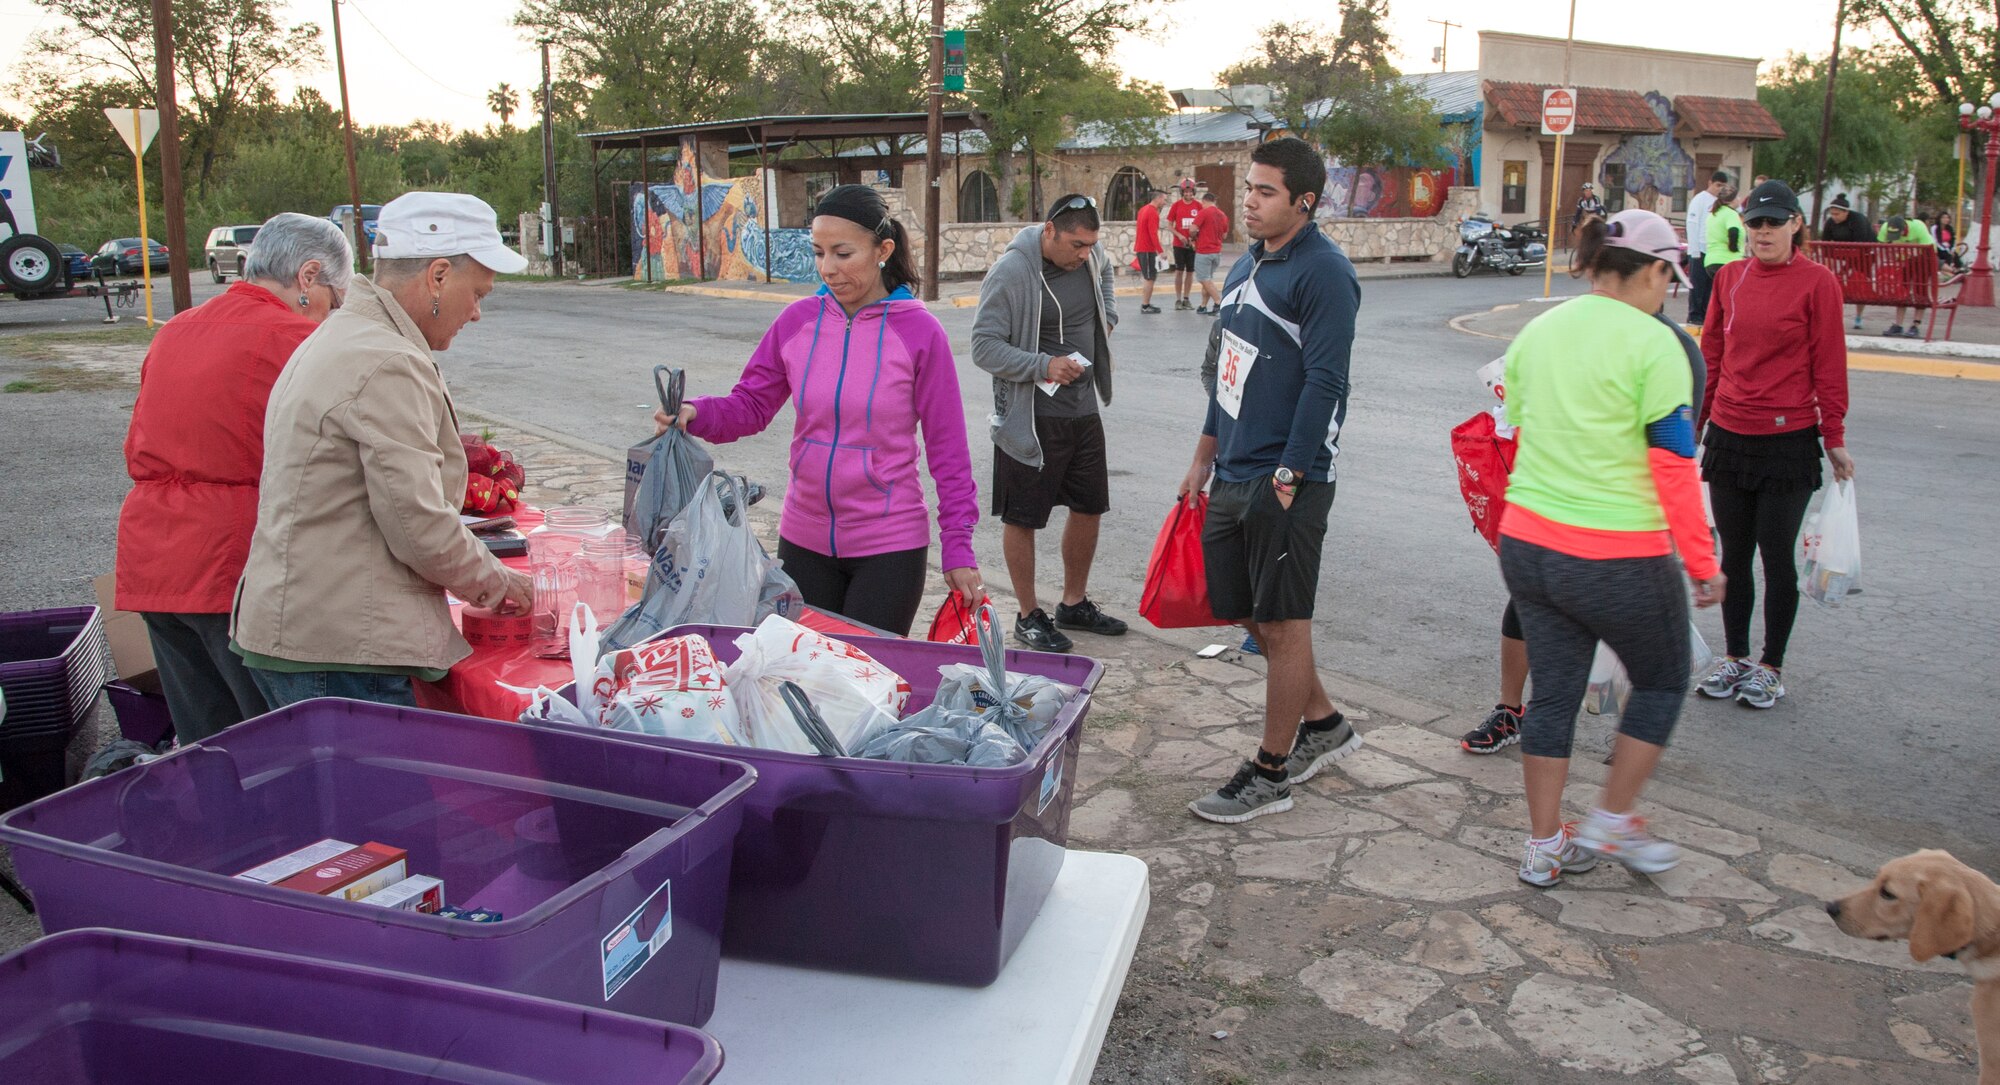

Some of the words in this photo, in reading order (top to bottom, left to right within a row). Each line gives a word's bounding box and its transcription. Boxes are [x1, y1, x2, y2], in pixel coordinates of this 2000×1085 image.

[1549, 97, 1558, 105] DO
[1559, 97, 1571, 105] NOT
[1548, 117, 1567, 125] ENTER
[1222, 348, 1240, 387] 36
